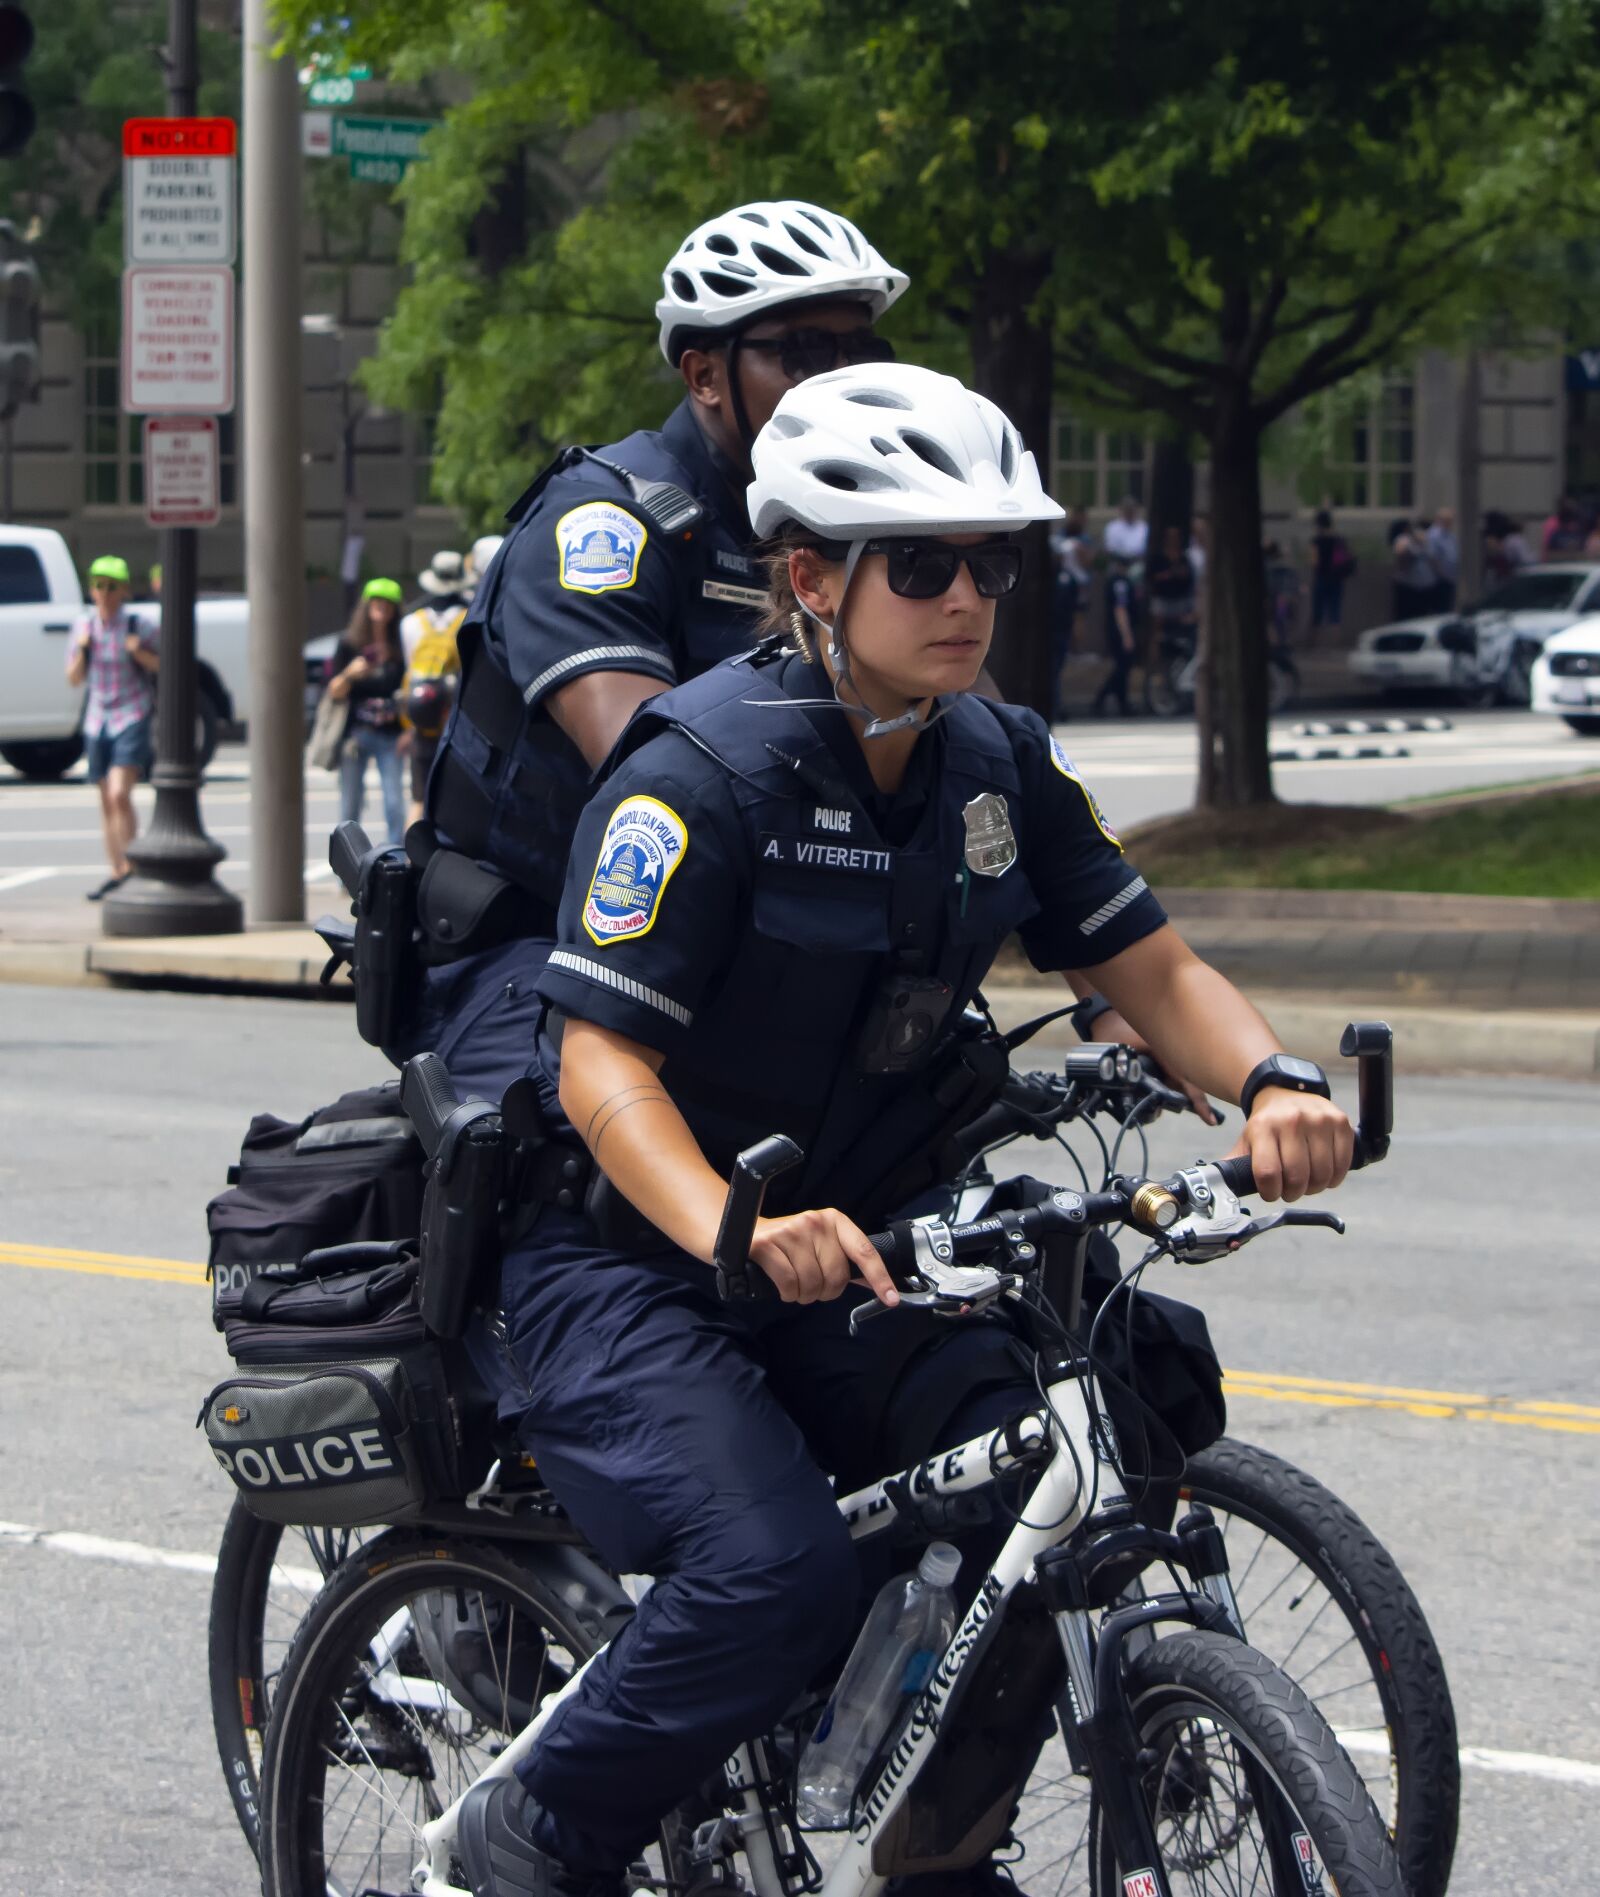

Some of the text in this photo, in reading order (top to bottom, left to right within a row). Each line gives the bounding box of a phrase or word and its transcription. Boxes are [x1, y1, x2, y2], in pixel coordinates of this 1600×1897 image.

[142, 131, 219, 149] NOTICE
[145, 183, 216, 199] PARKING
[717, 549, 749, 573] POLICE
[608, 810, 681, 855] METROPOLITAN POLICE
[814, 807, 852, 833] POLICE
[634, 835, 659, 863] OMNIBUS
[763, 839, 890, 871] A. VITERETTI
[608, 913, 646, 931] COLUMBIA
[213, 1428, 393, 1486] POLICE
